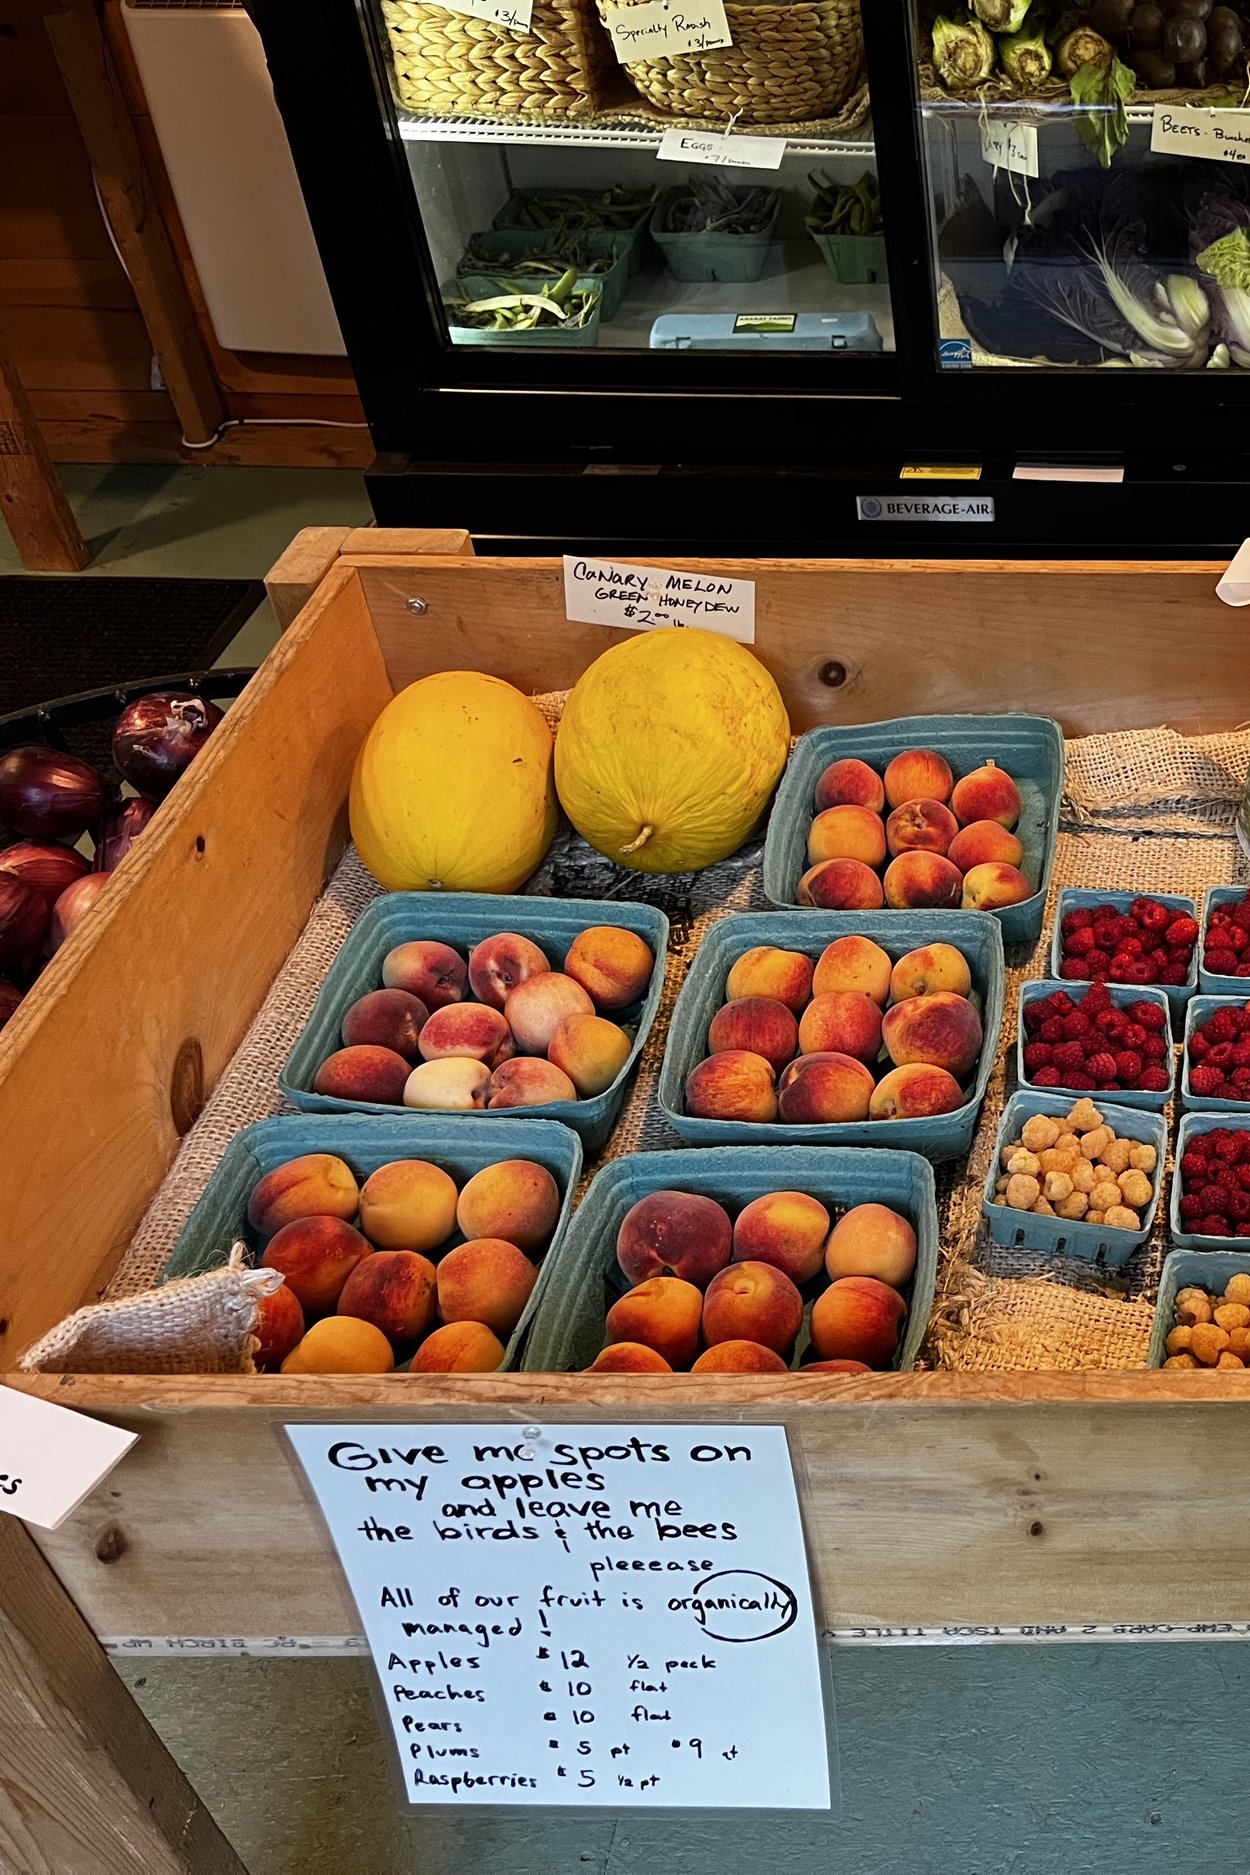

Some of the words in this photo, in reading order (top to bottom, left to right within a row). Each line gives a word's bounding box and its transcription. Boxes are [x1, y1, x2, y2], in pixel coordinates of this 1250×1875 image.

[615, 24, 668, 42] Specialty
[1160, 114, 1201, 136] BEETS
[887, 503, 990, 515] BEVERAGE-AIR
[665, 574, 732, 595] MELON
[595, 588, 649, 604] GREEN
[327, 1441, 449, 1471] Give
[549, 1436, 671, 1471] spots
[690, 1445, 752, 1462] on
[364, 1475, 428, 1501] my
[461, 1468, 605, 1500] apples
[441, 1499, 497, 1518] and
[516, 1498, 611, 1518] leave
[630, 1500, 683, 1517] me
[358, 1515, 413, 1543] the
[432, 1519, 541, 1541] birds
[585, 1519, 635, 1541] the
[655, 1517, 739, 1541] bees
[589, 1555, 714, 1583] pleeease
[380, 1586, 414, 1608] All
[437, 1587, 460, 1608] of
[474, 1594, 519, 1608] our
[539, 1585, 607, 1608] fruit
[622, 1591, 644, 1611] is
[667, 1591, 793, 1627] organically
[851, 1627, 927, 1638] TITLE
[943, 1625, 1004, 1637] TSCA
[1020, 1625, 1068, 1636] AND
[387, 1651, 481, 1676] Apples
[393, 1684, 486, 1703] Peaches
[629, 1679, 668, 1693] flat
[402, 1715, 463, 1734] Pears
[630, 1704, 672, 1722] flat
[410, 1743, 480, 1759] Plums
[610, 1742, 631, 1760] pt
[414, 1767, 538, 1794] Raspberries
[639, 1773, 661, 1791] pt
